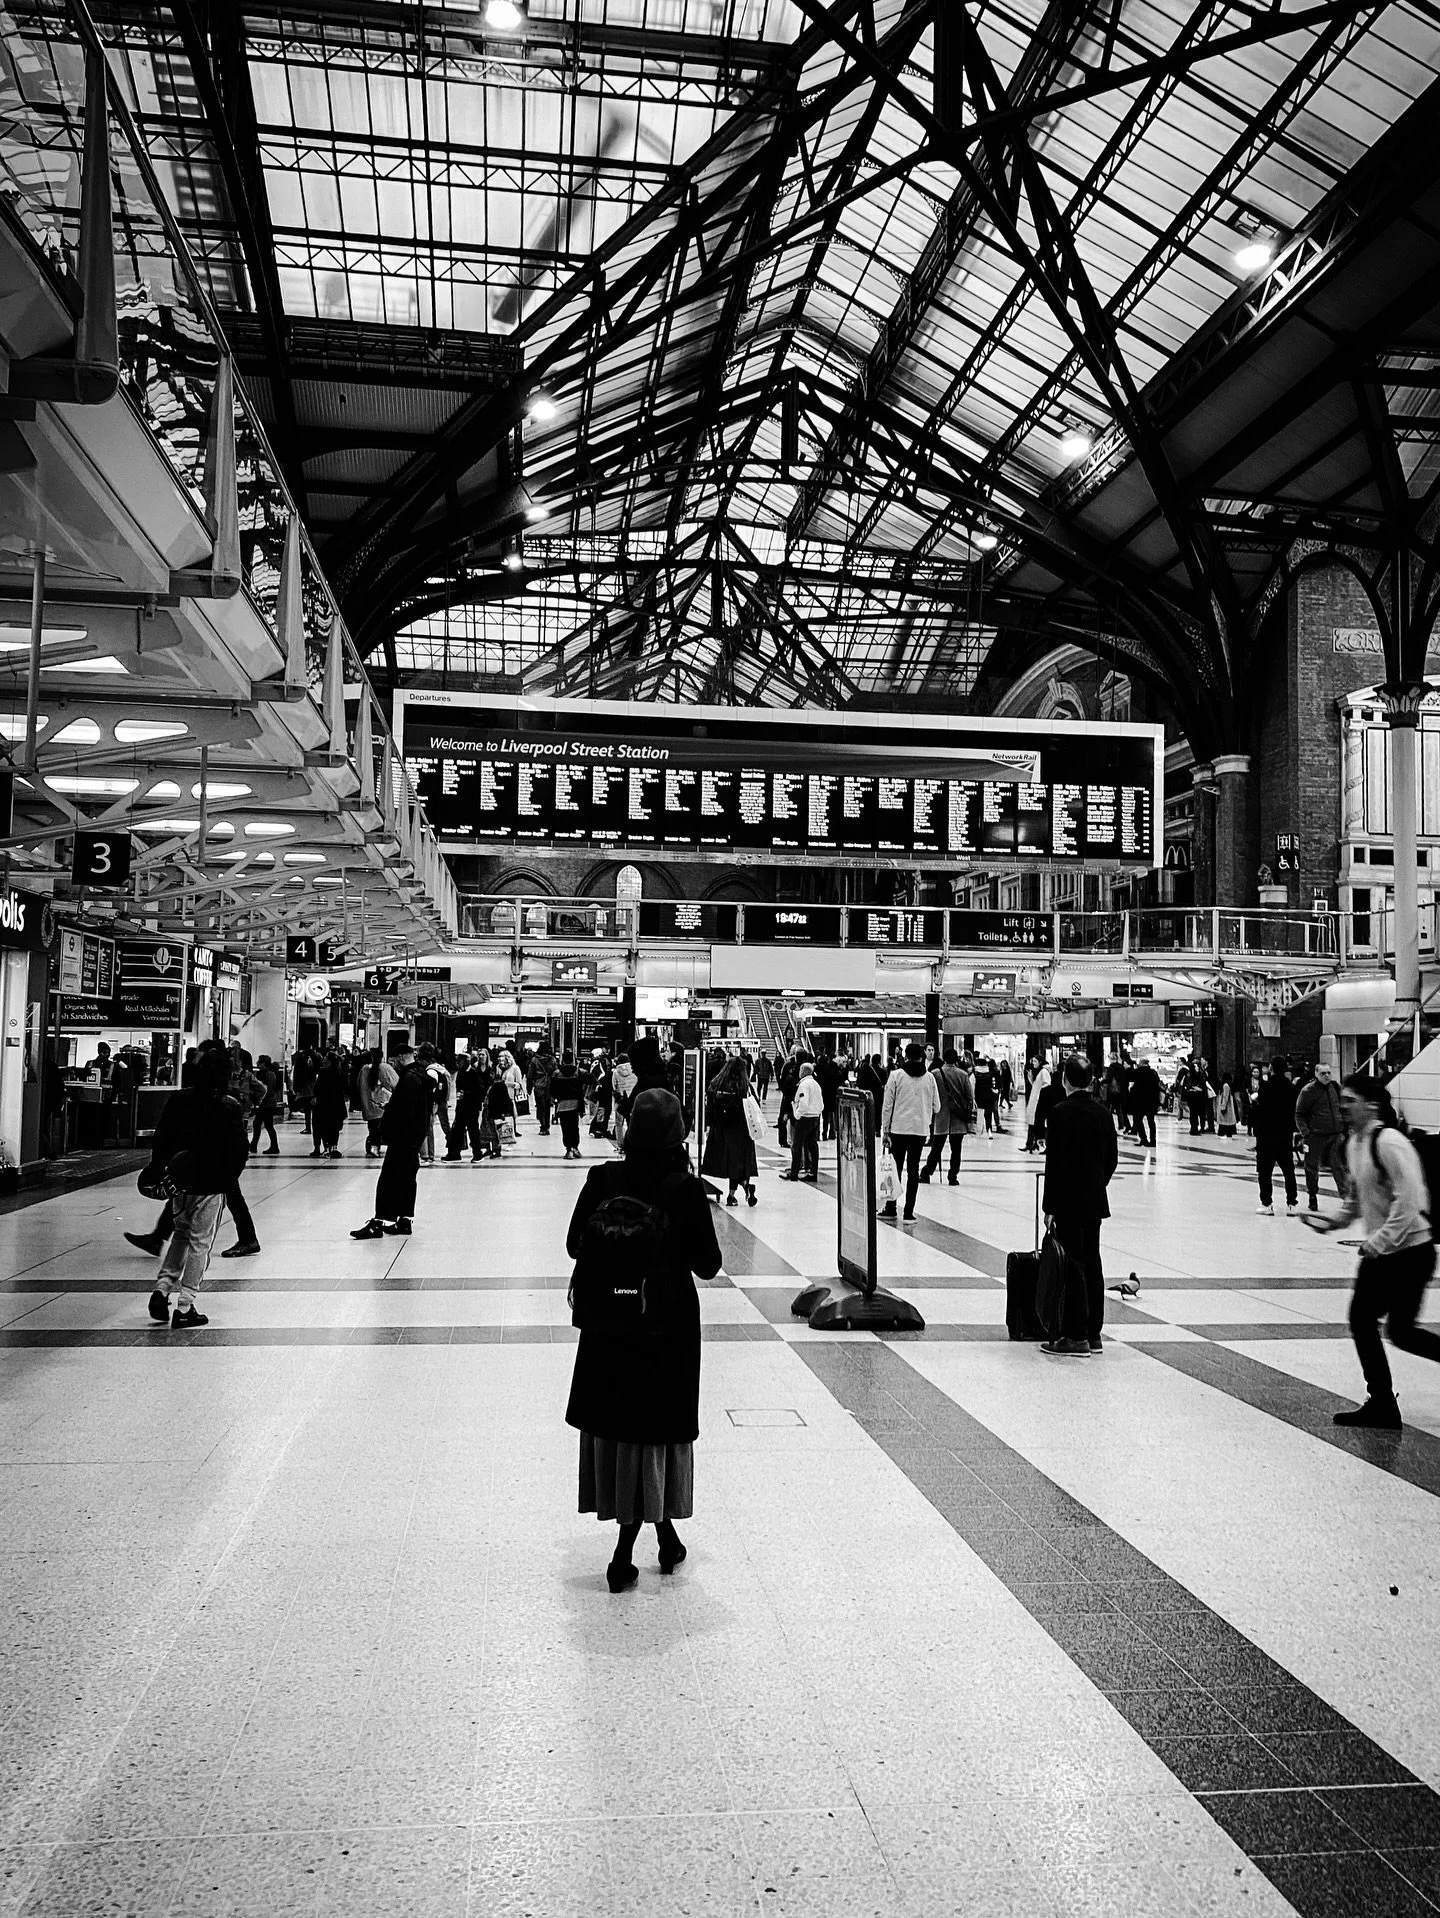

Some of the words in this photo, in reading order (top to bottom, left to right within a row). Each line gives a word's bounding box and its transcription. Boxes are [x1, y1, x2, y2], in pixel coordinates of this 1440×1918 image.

[409, 693, 452, 703] Departures
[429, 736, 483, 752] Welcome
[486, 741, 499, 753] to
[501, 739, 568, 758] Liverpool
[570, 742, 614, 758] Street
[616, 744, 669, 760] Station
[90, 842, 111, 874] 3
[0, 891, 26, 932] olis
[1003, 918, 1019, 927] Lift
[977, 931, 1008, 942] Toilets
[294, 941, 308, 957] 4
[326, 946, 337, 961] 5
[370, 974, 379, 986] 6
[385, 980, 393, 992] 7
[421, 997, 427, 1007] 8
[439, 1005, 448, 1014] 10
[51, 1012, 69, 1020] Fsh
[70, 1012, 109, 1020] Sandwiches
[614, 1287, 638, 1295] Lenovo
